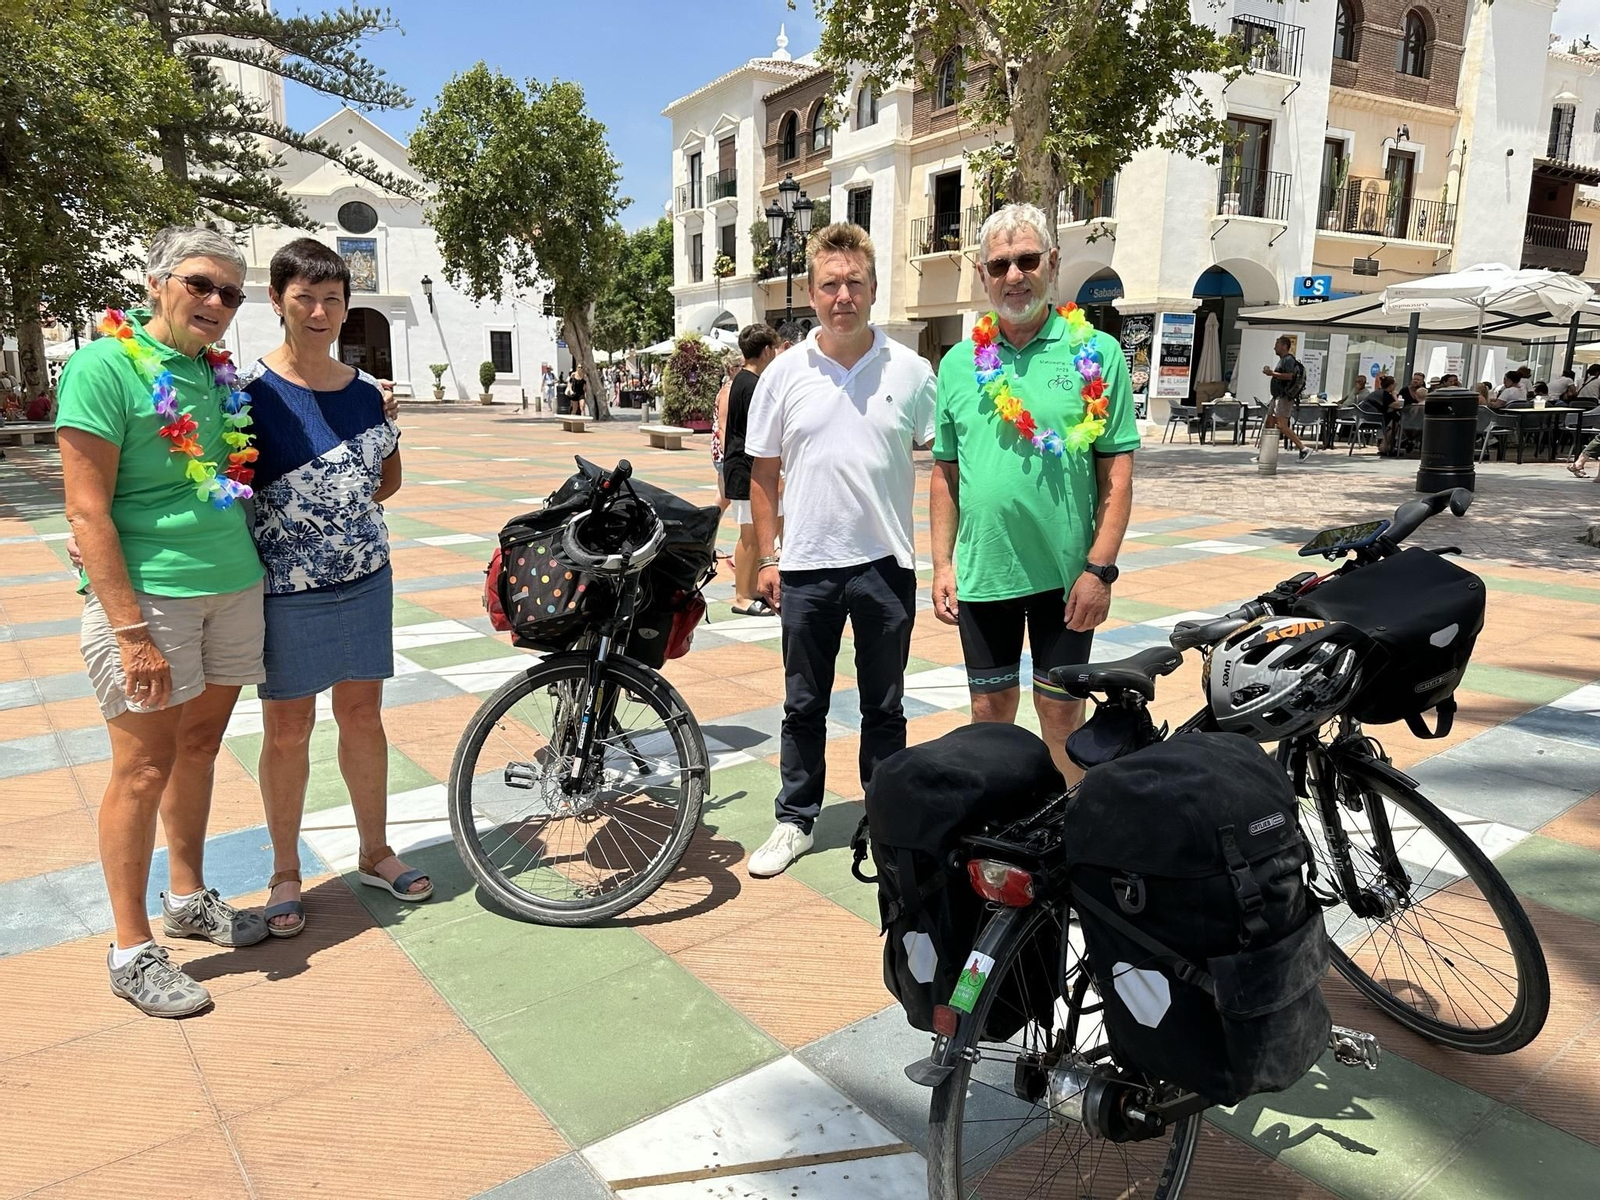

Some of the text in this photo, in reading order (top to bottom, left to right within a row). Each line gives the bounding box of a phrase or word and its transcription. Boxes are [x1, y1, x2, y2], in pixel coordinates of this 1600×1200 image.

[1093, 287, 1123, 298] Sabadel
[1313, 279, 1325, 295] S
[1222, 660, 1231, 687] uvex
